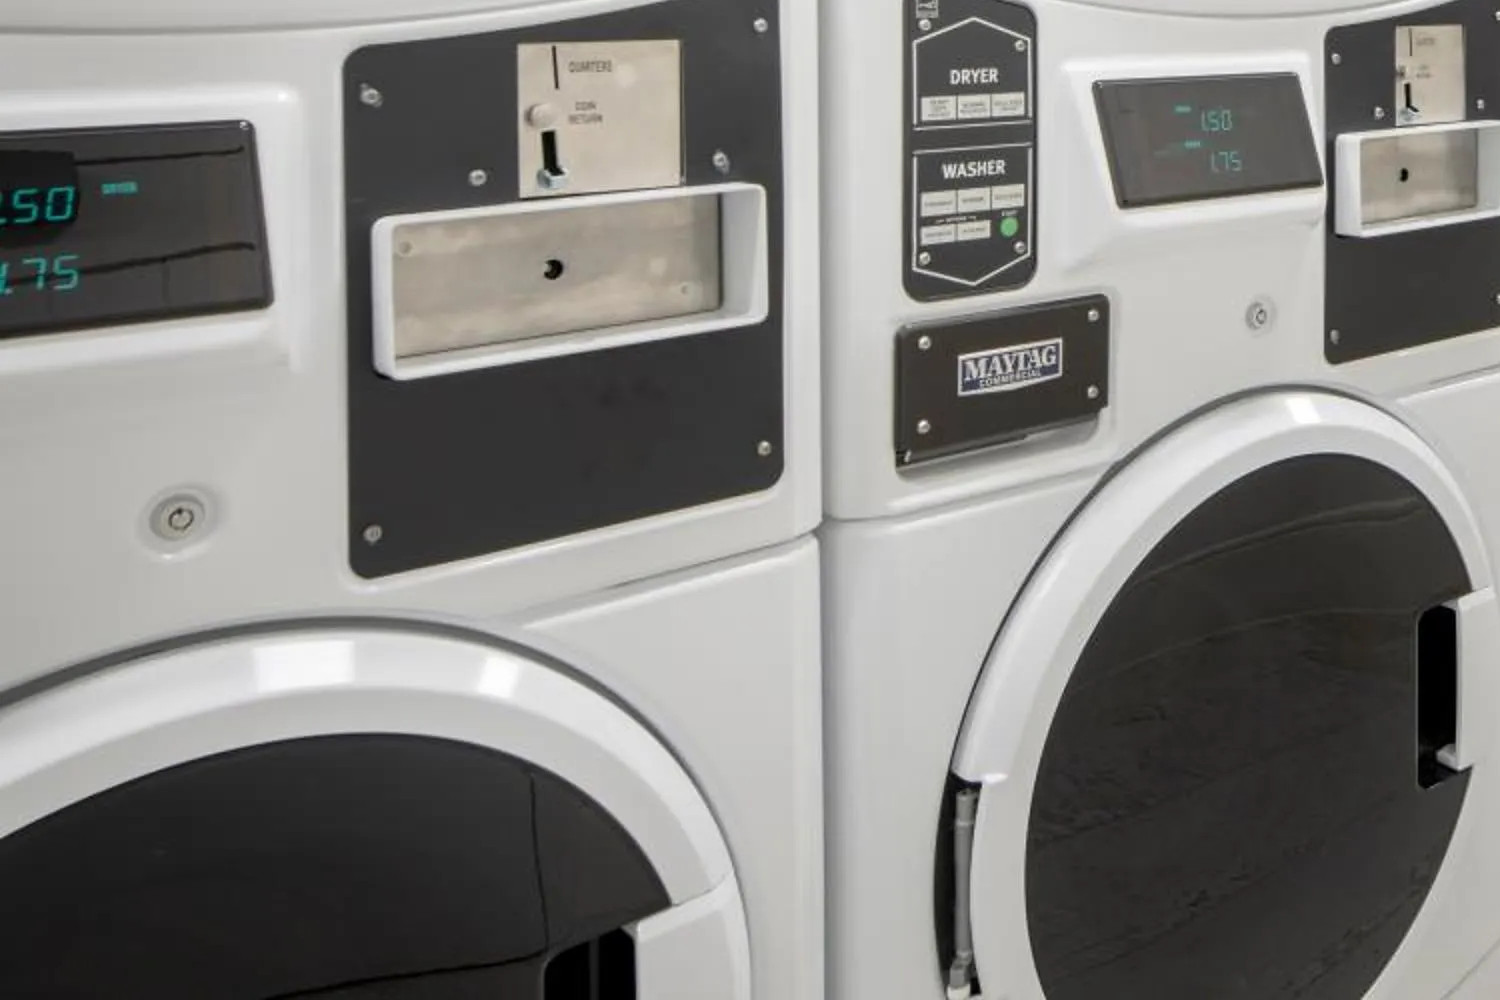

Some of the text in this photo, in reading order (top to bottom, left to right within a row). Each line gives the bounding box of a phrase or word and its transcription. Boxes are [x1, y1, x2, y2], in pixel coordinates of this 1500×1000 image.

[950, 67, 999, 85] DRYER
[942, 159, 1006, 179] WASHER
[964, 345, 1057, 381] MAYTAG
